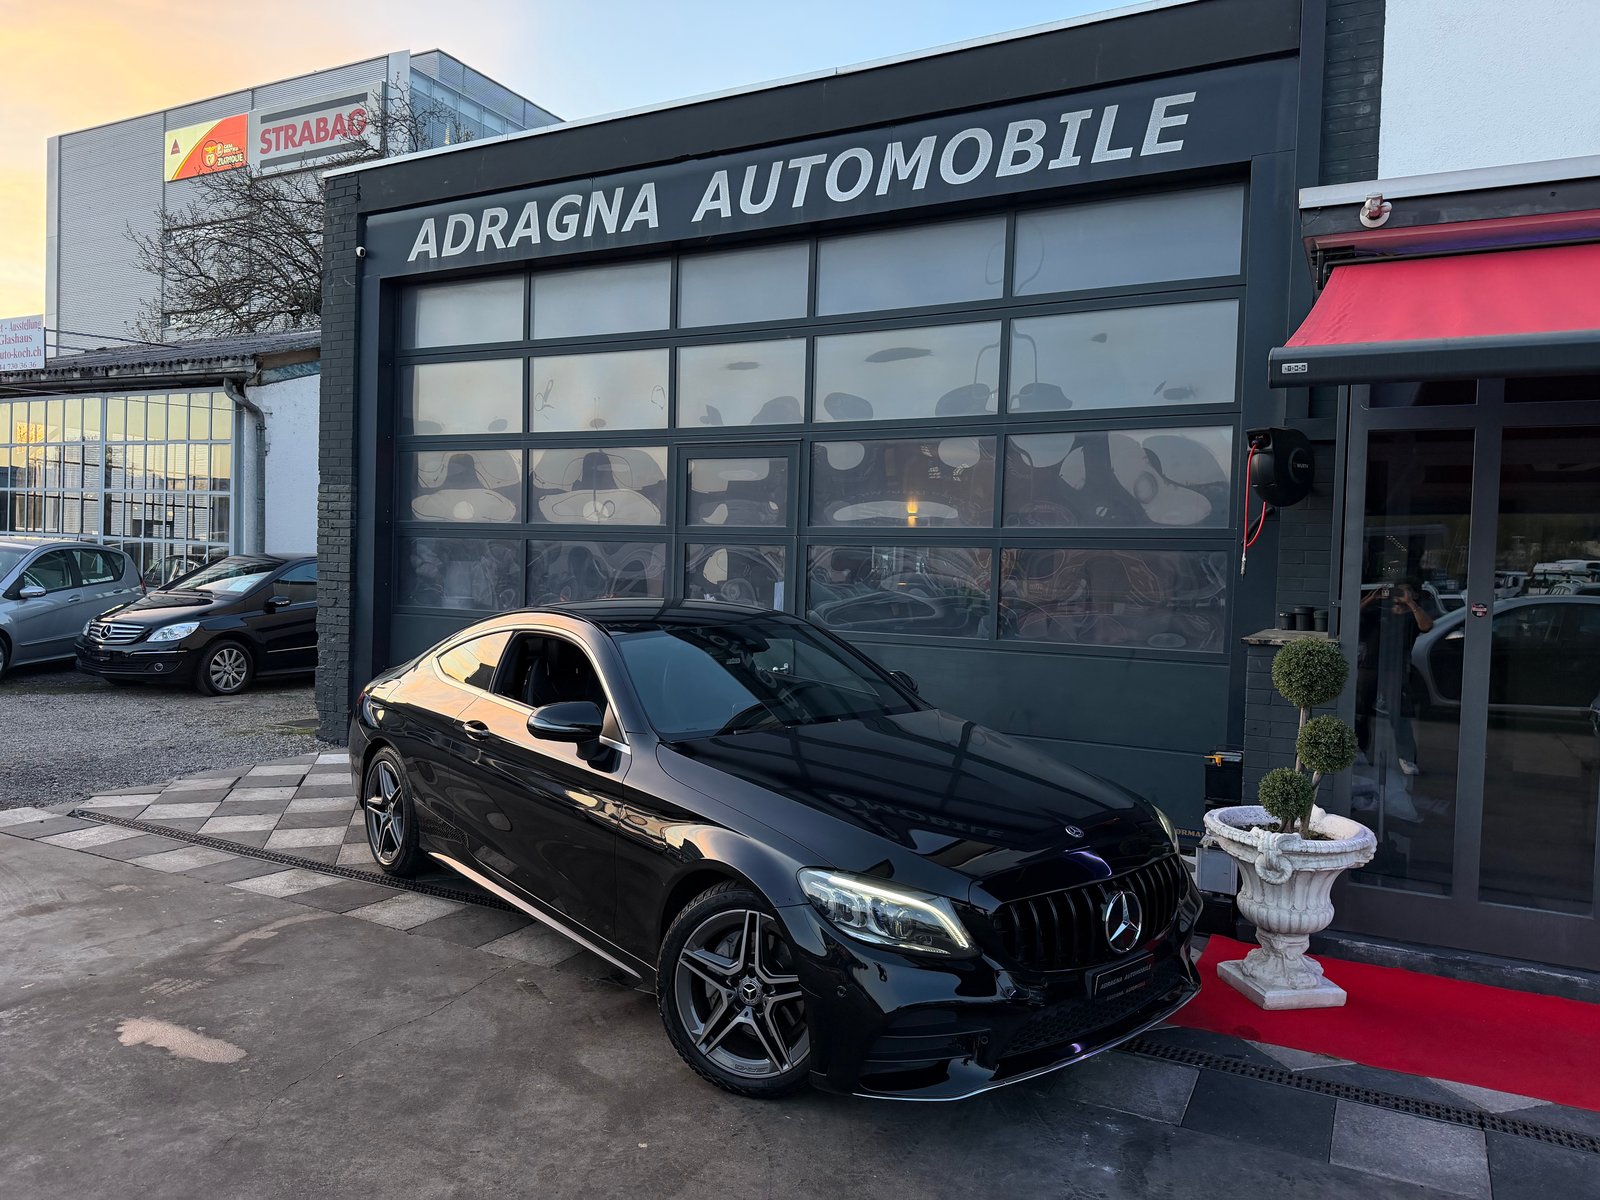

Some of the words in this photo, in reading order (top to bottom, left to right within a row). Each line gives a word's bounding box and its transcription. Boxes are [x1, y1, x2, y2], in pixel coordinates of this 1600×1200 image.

[259, 108, 367, 155] STRABAG
[407, 182, 659, 262] ADRAGNA
[691, 91, 1197, 222] AUTOMOBILE
[0, 346, 42, 359] uto-koch.ch
